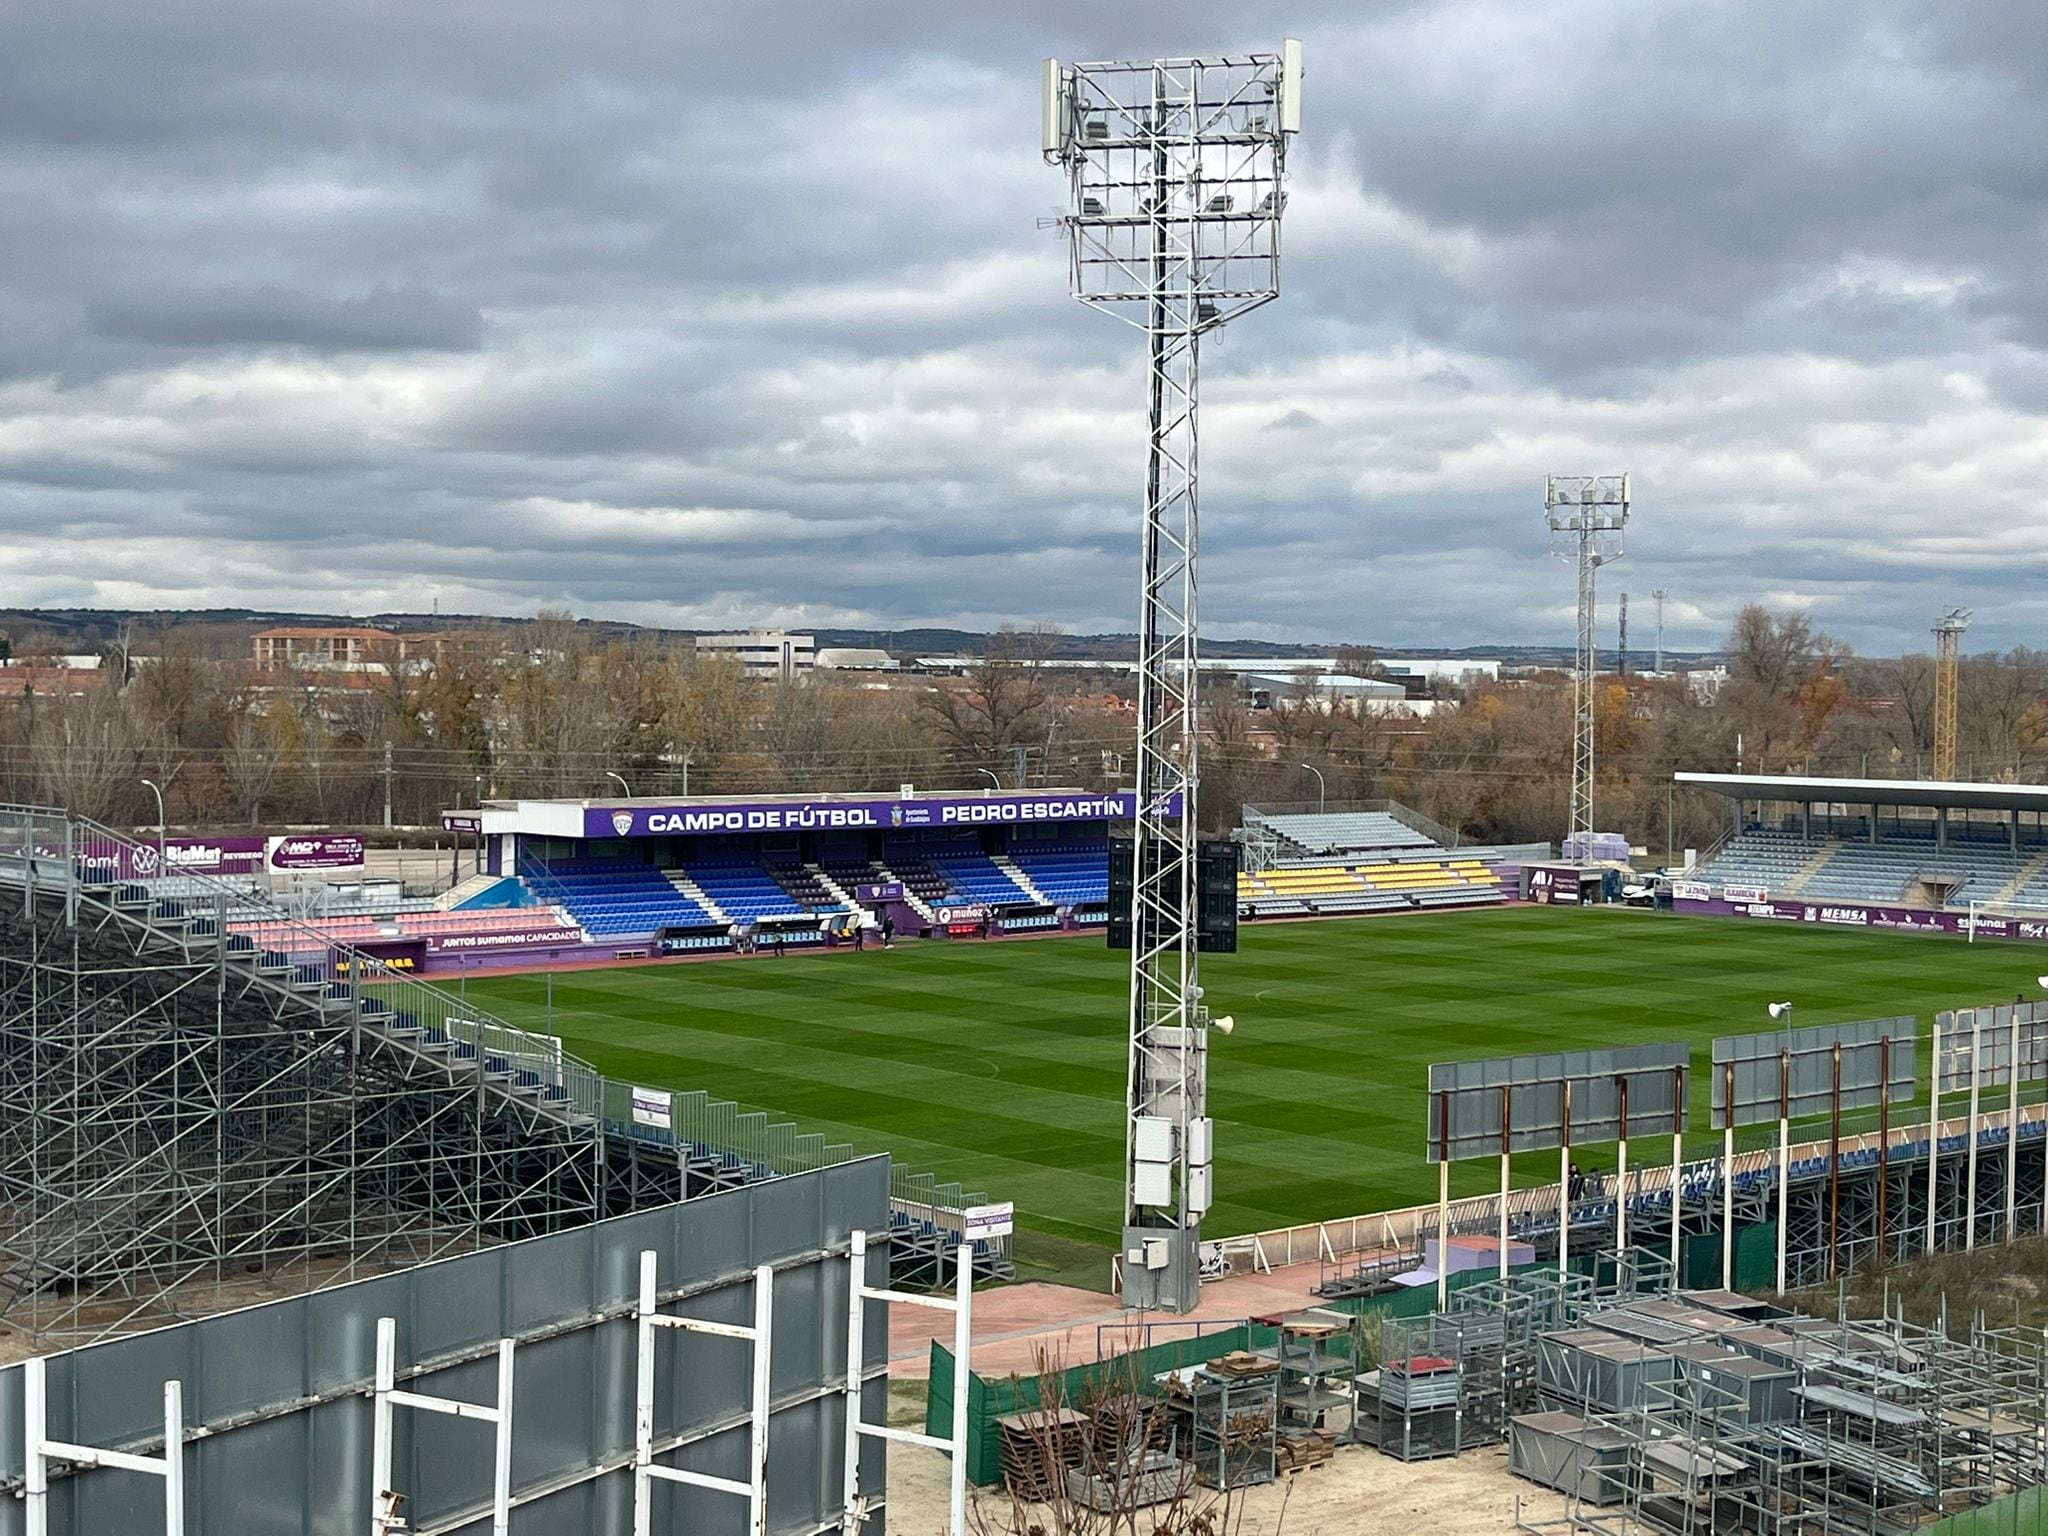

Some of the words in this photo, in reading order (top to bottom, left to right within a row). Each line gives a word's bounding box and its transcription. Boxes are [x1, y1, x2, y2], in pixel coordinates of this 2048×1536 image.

[648, 812, 744, 832] CAMPO
[747, 810, 781, 829] DE
[785, 805, 877, 828] FÚTBOL
[942, 804, 1017, 823] PEDRO
[1020, 796, 1124, 820] ESCARTÍN
[166, 844, 222, 865] BigMat
[952, 907, 984, 918] muñoz
[1820, 907, 1868, 921] MEMSA
[442, 937, 476, 948] JUNTOS
[477, 933, 526, 945] sumamos
[526, 930, 580, 943] CAPACIDADES
